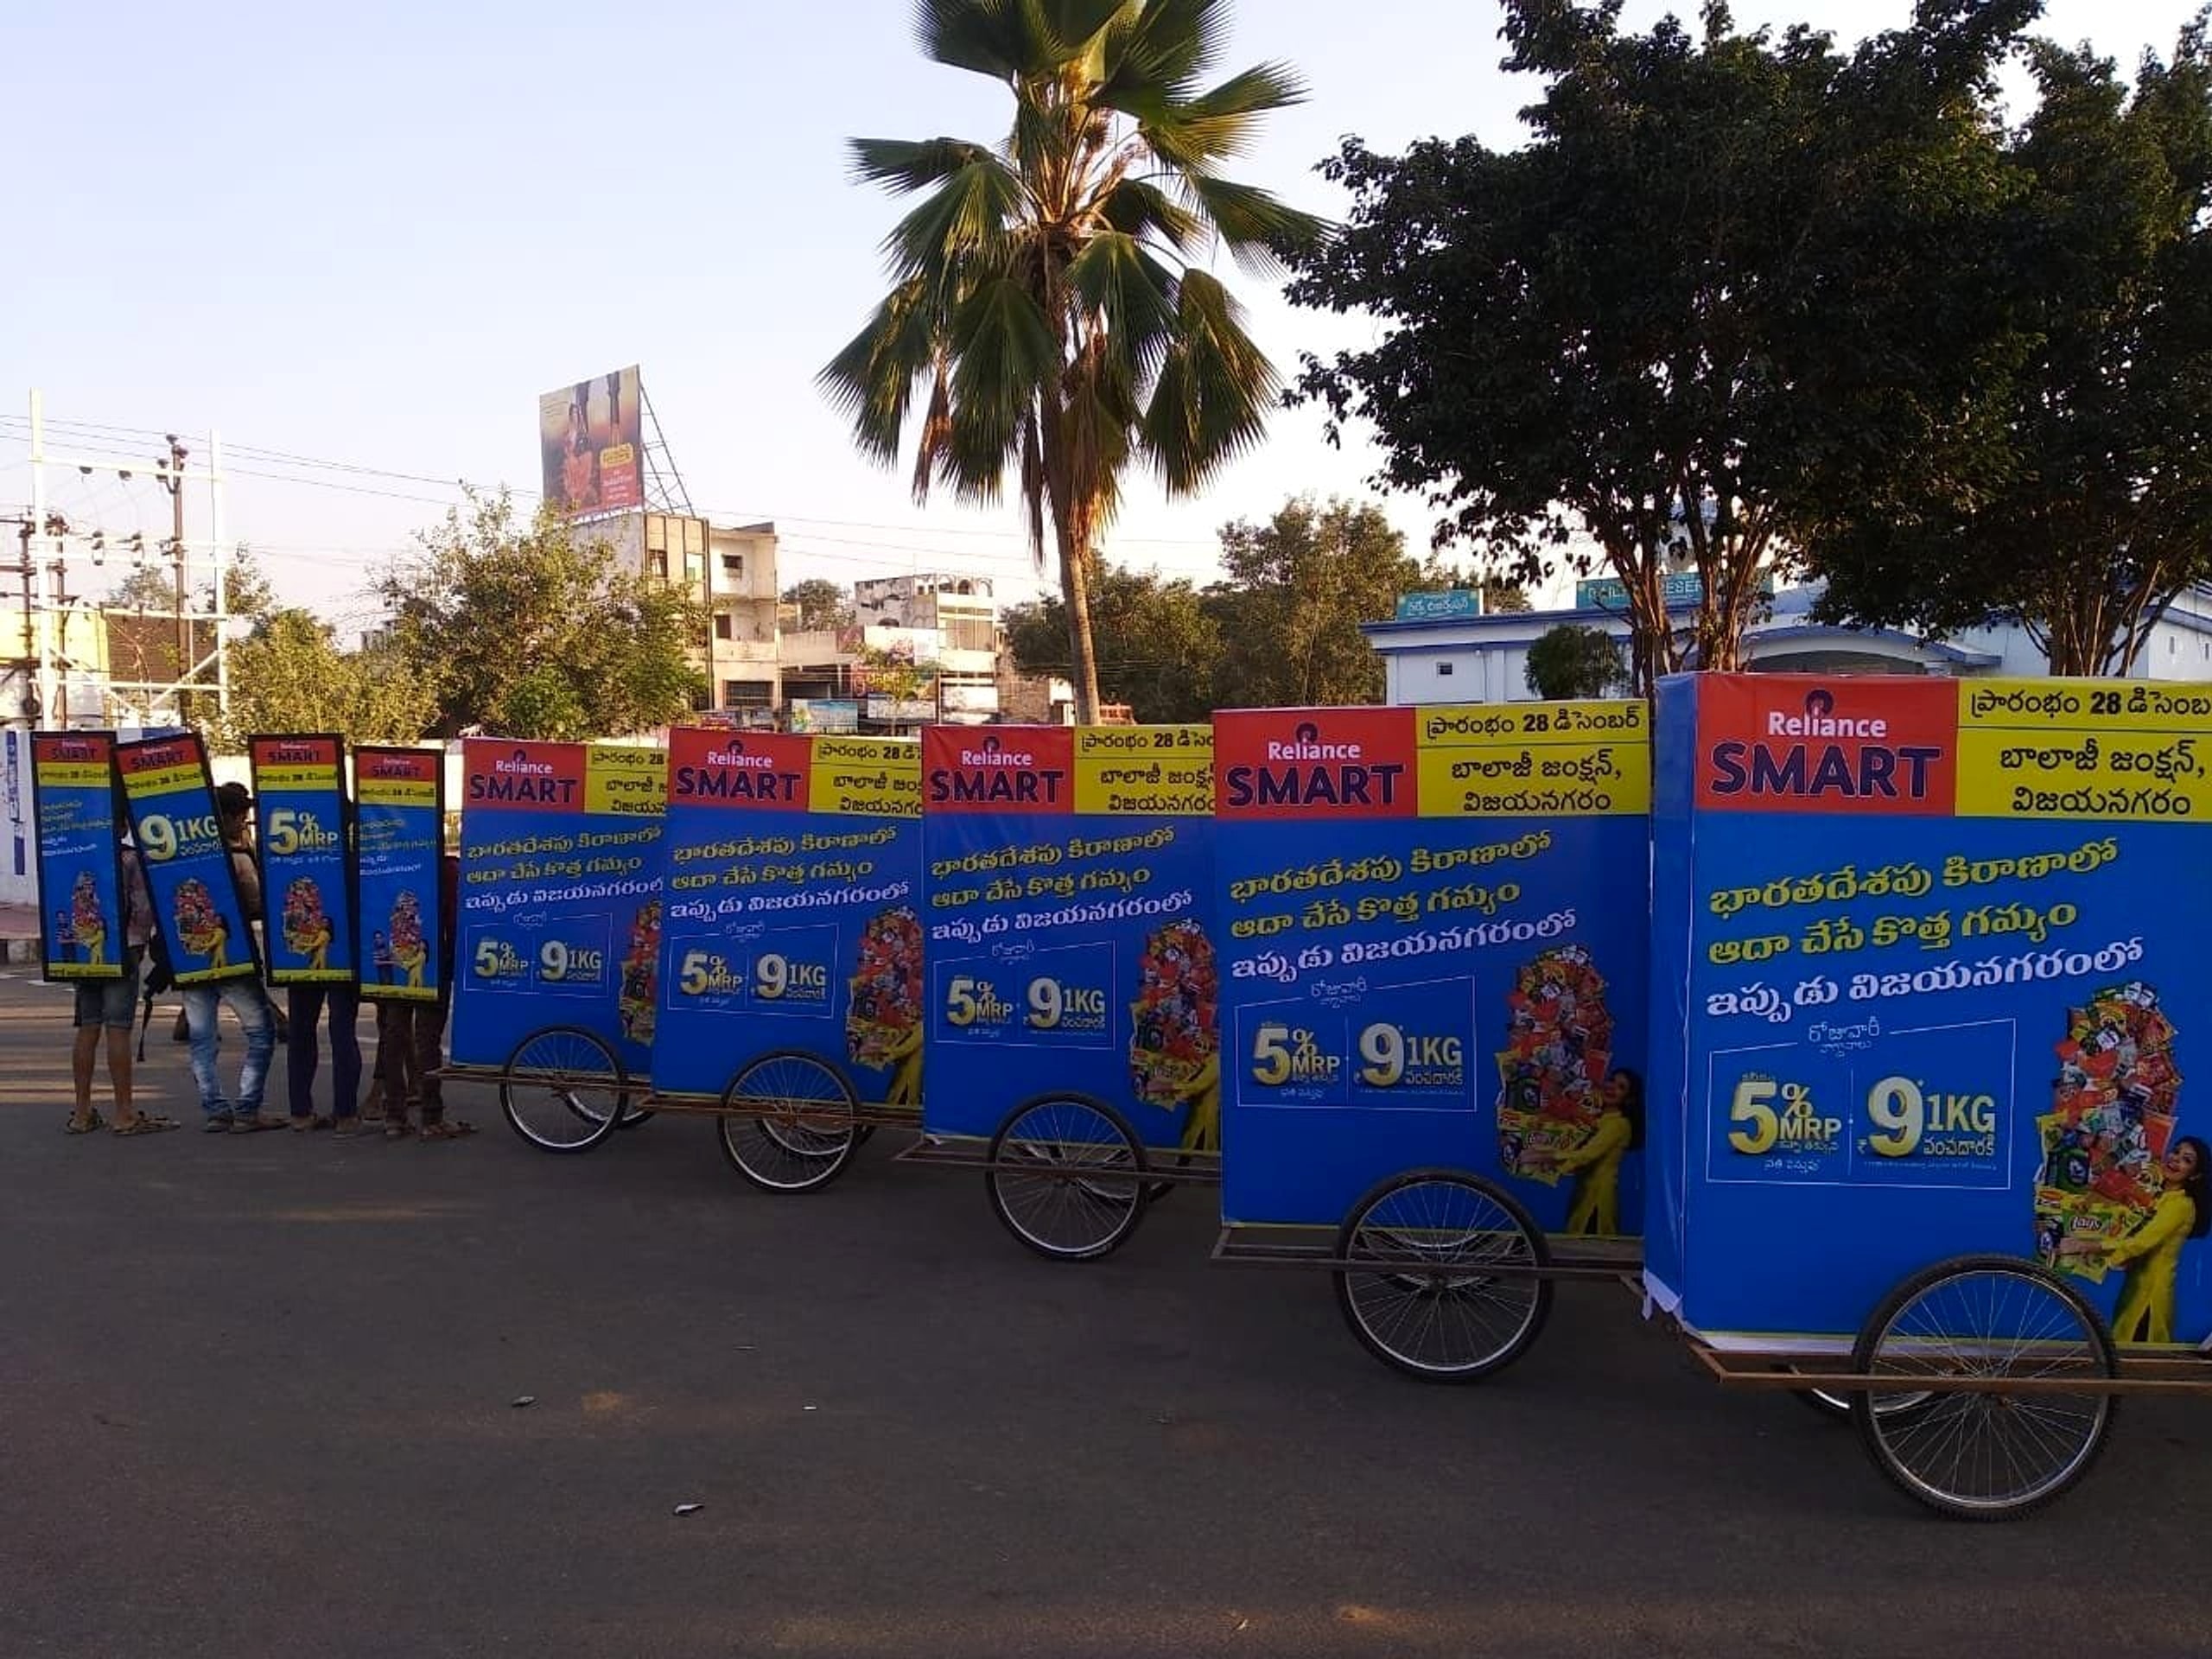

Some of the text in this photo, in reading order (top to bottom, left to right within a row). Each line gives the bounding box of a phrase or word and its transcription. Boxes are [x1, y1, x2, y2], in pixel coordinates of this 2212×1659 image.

[1971, 686, 2211, 718] ప్రారంభం 28 డిసెంబ
[1427, 716, 1515, 738] ప్రారంభం
[1523, 714, 1548, 732] 28
[1769, 712, 1886, 738] Reliance
[1154, 733, 1173, 747] 28
[1268, 741, 1360, 760] Reliance
[131, 751, 186, 768] SMART
[267, 750, 320, 761] SMART
[708, 753, 773, 768] Reliance
[883, 747, 900, 760] 28
[962, 749, 1033, 766] Reliance
[1451, 752, 1532, 779] బాలాజీ
[2000, 738, 2099, 770] బాలాజీ
[496, 760, 553, 774] Reliance
[1711, 742, 1942, 798] SMART
[470, 774, 577, 803] SMART
[676, 768, 801, 801] SMART
[930, 769, 1065, 804] SMART
[1225, 763, 1403, 806] SMART
[1463, 790, 1611, 814] విజయనగరం
[2012, 785, 2191, 815] విజయనగరం
[175, 816, 219, 842] 1KG
[299, 831, 339, 848] MRP
[1230, 830, 1551, 903] భారతదేశపు కిరాణాలో
[1709, 837, 2117, 919] భారతదేశపు కిరాణాలో
[1231, 880, 1520, 939] ఆదా చేసే కొత్త గమ్యం
[1709, 902, 2077, 963] ఆదా చేసే కొత్త గమ్యం
[1231, 909, 1576, 983] ఇప్పుడు విజయనగరంలో
[567, 950, 602, 969] 1KG
[708, 976, 743, 988] MRP
[788, 964, 826, 986] 1KG
[1707, 937, 2144, 1023] ఇప్పుడు విజయనగరంలో
[975, 1002, 1014, 1018] MRP
[1064, 989, 1106, 1014] 1KG
[1406, 1036, 1463, 1066] 1KG
[1292, 1056, 1341, 1074] MRP
[1927, 1094, 1995, 1133] 1KG
[1780, 1118, 1842, 1141] MRP
